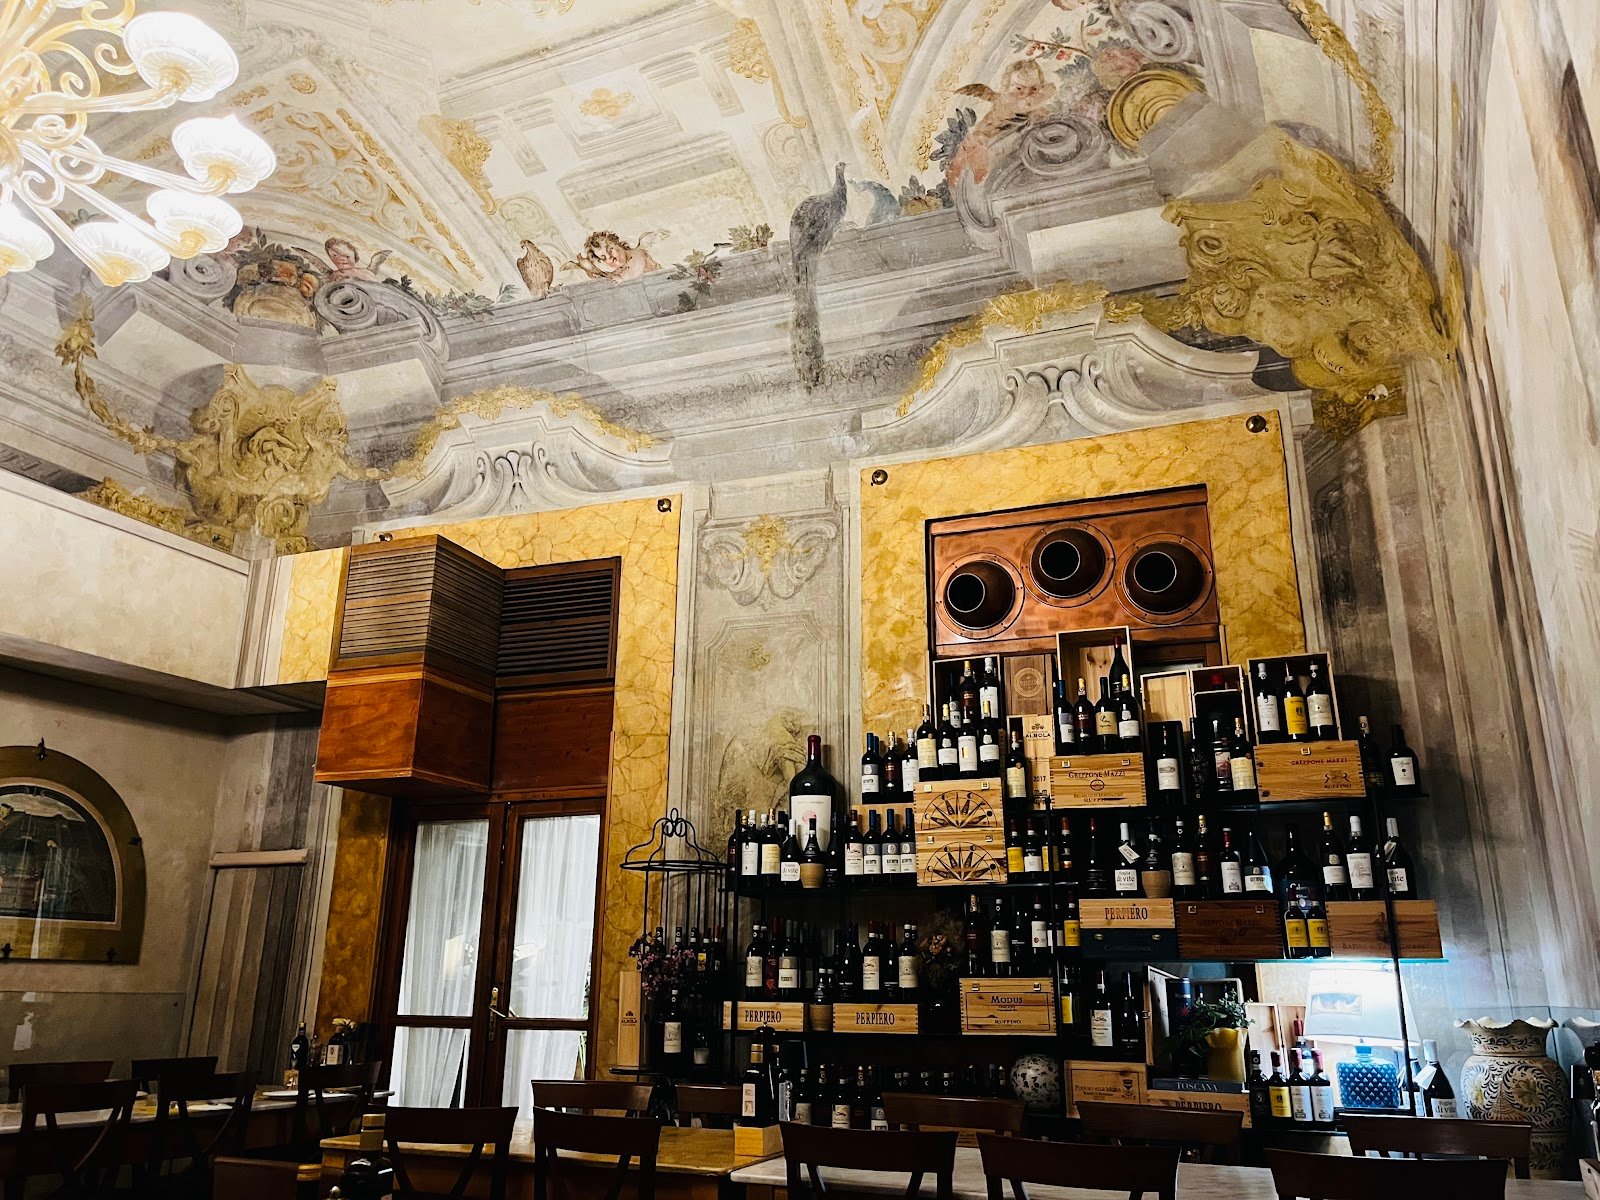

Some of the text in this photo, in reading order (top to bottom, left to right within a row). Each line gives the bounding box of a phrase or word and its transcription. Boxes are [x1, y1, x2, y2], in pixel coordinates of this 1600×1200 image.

[1104, 769, 1126, 777] MAZZI
[1123, 874, 1136, 883] vite
[1104, 907, 1148, 920] PERPIERO
[745, 1010, 782, 1023] PERPIERO
[856, 1011, 895, 1025] PERPIERO
[1175, 1082, 1218, 1092] TOSCANA
